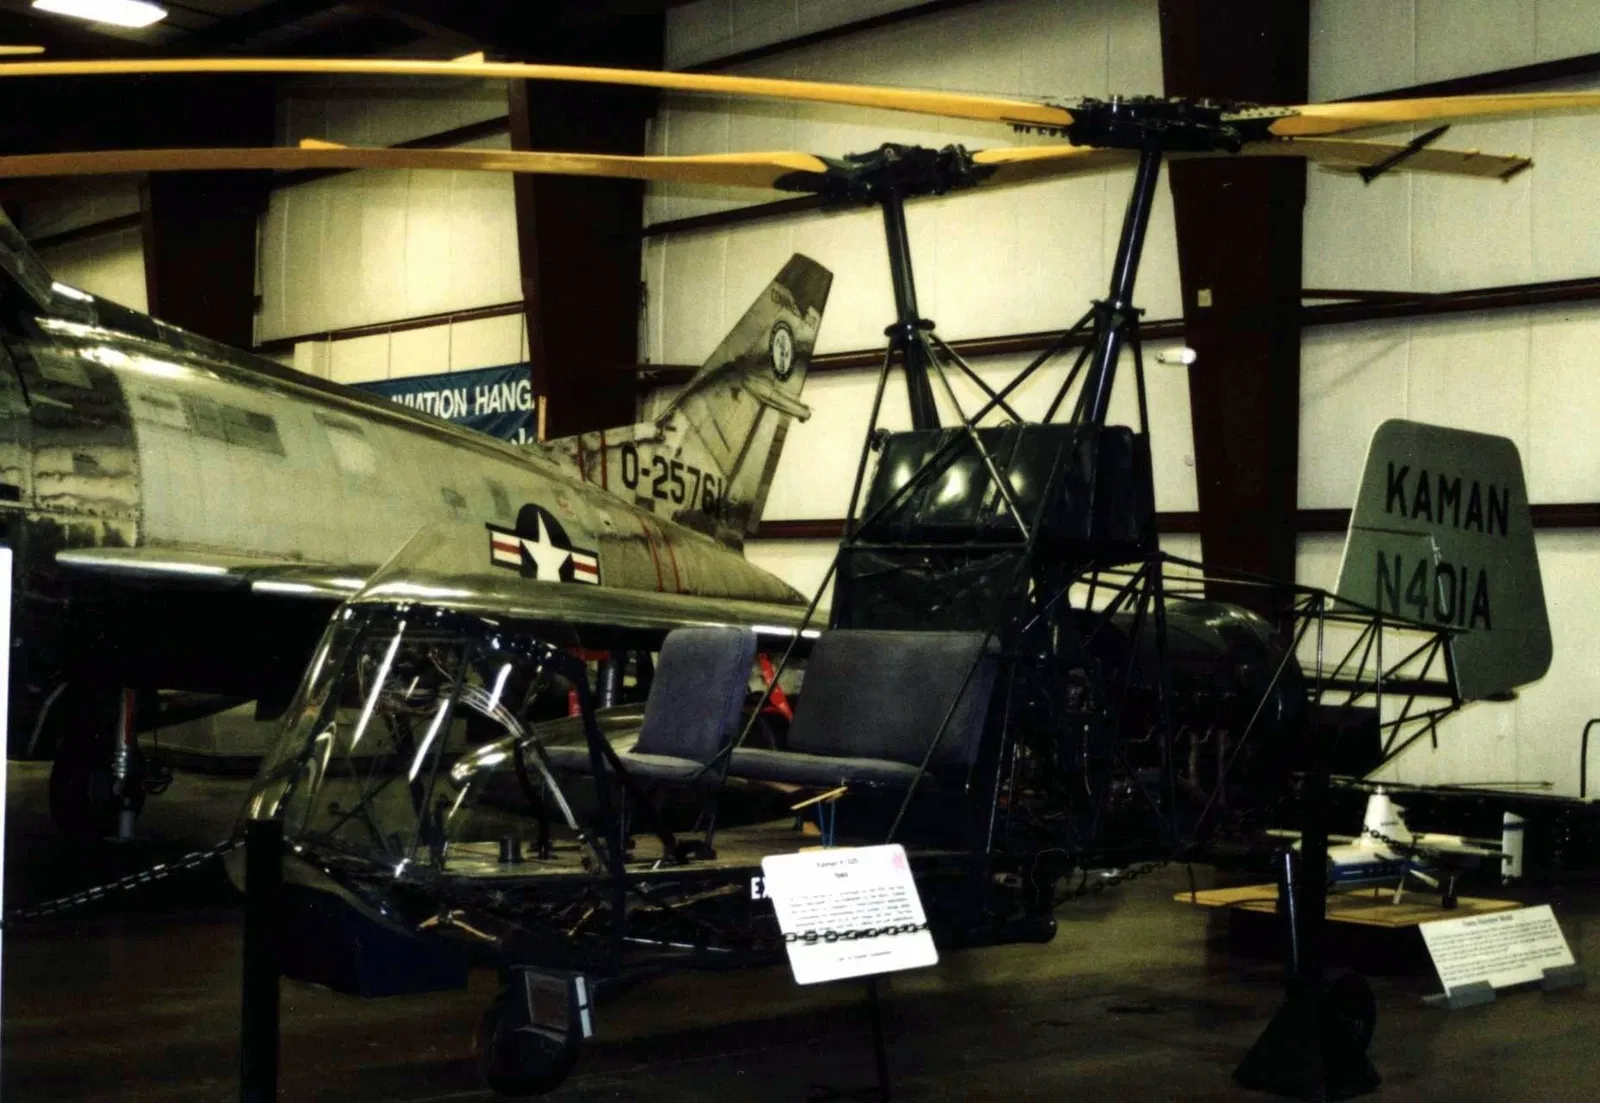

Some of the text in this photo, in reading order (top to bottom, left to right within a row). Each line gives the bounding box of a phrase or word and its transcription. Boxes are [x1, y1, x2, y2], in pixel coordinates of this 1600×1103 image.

[475, 379, 535, 415] HANG
[1385, 461, 1510, 537] KAMAN
[1375, 550, 1492, 630] N401A
